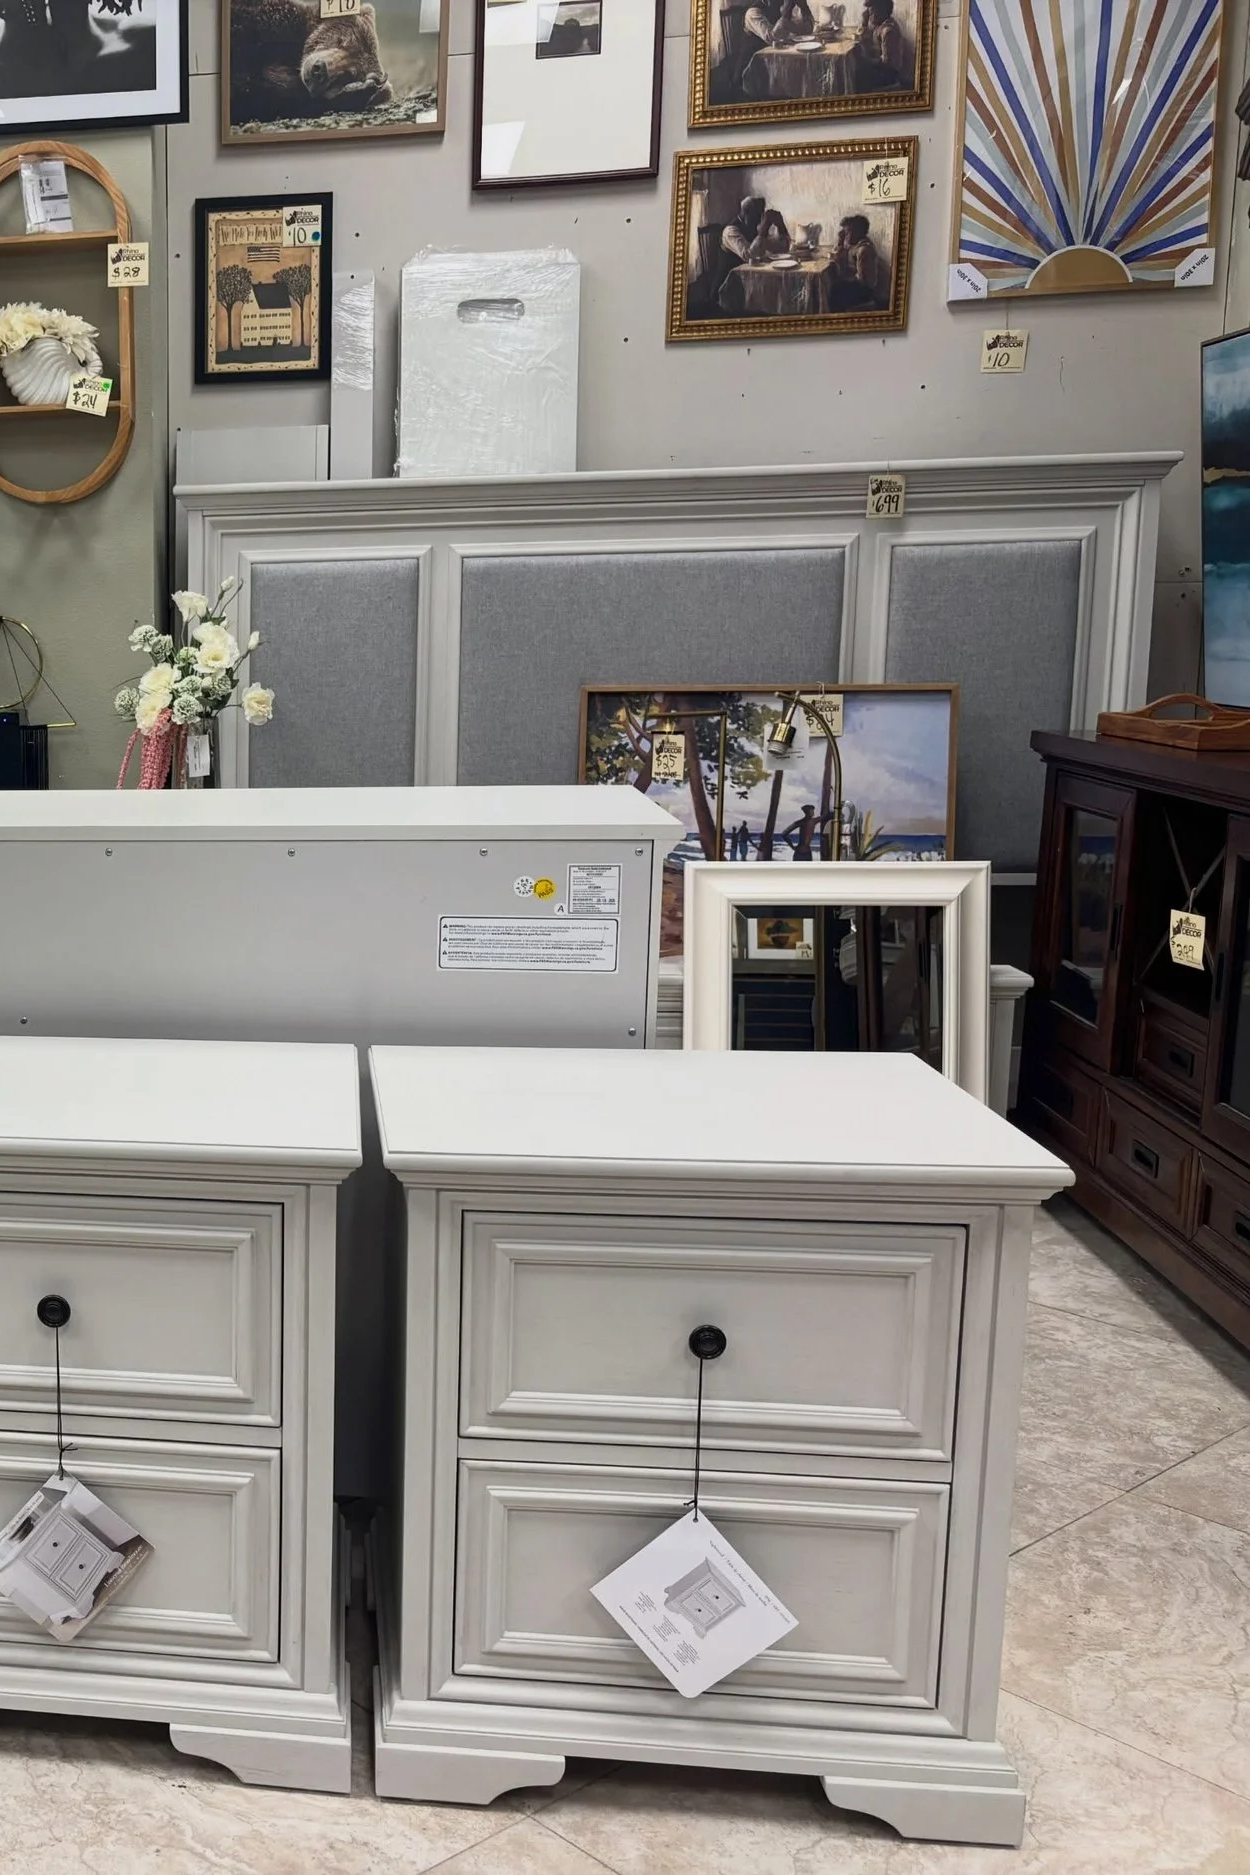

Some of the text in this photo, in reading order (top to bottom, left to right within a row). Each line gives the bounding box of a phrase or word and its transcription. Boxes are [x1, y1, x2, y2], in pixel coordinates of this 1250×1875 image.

[879, 169, 905, 178] DECOR
[867, 178, 891, 198] $16
[296, 216, 320, 224] DECOR
[122, 254, 146, 262] DECOR
[1195, 254, 1209, 267] 20in
[111, 266, 141, 280] $28
[999, 341, 1024, 349] DECOR
[72, 391, 98, 410] $24
[816, 705, 840, 713] DECOR
[557, 904, 565, 913] A
[1181, 927, 1202, 939] DECOR
